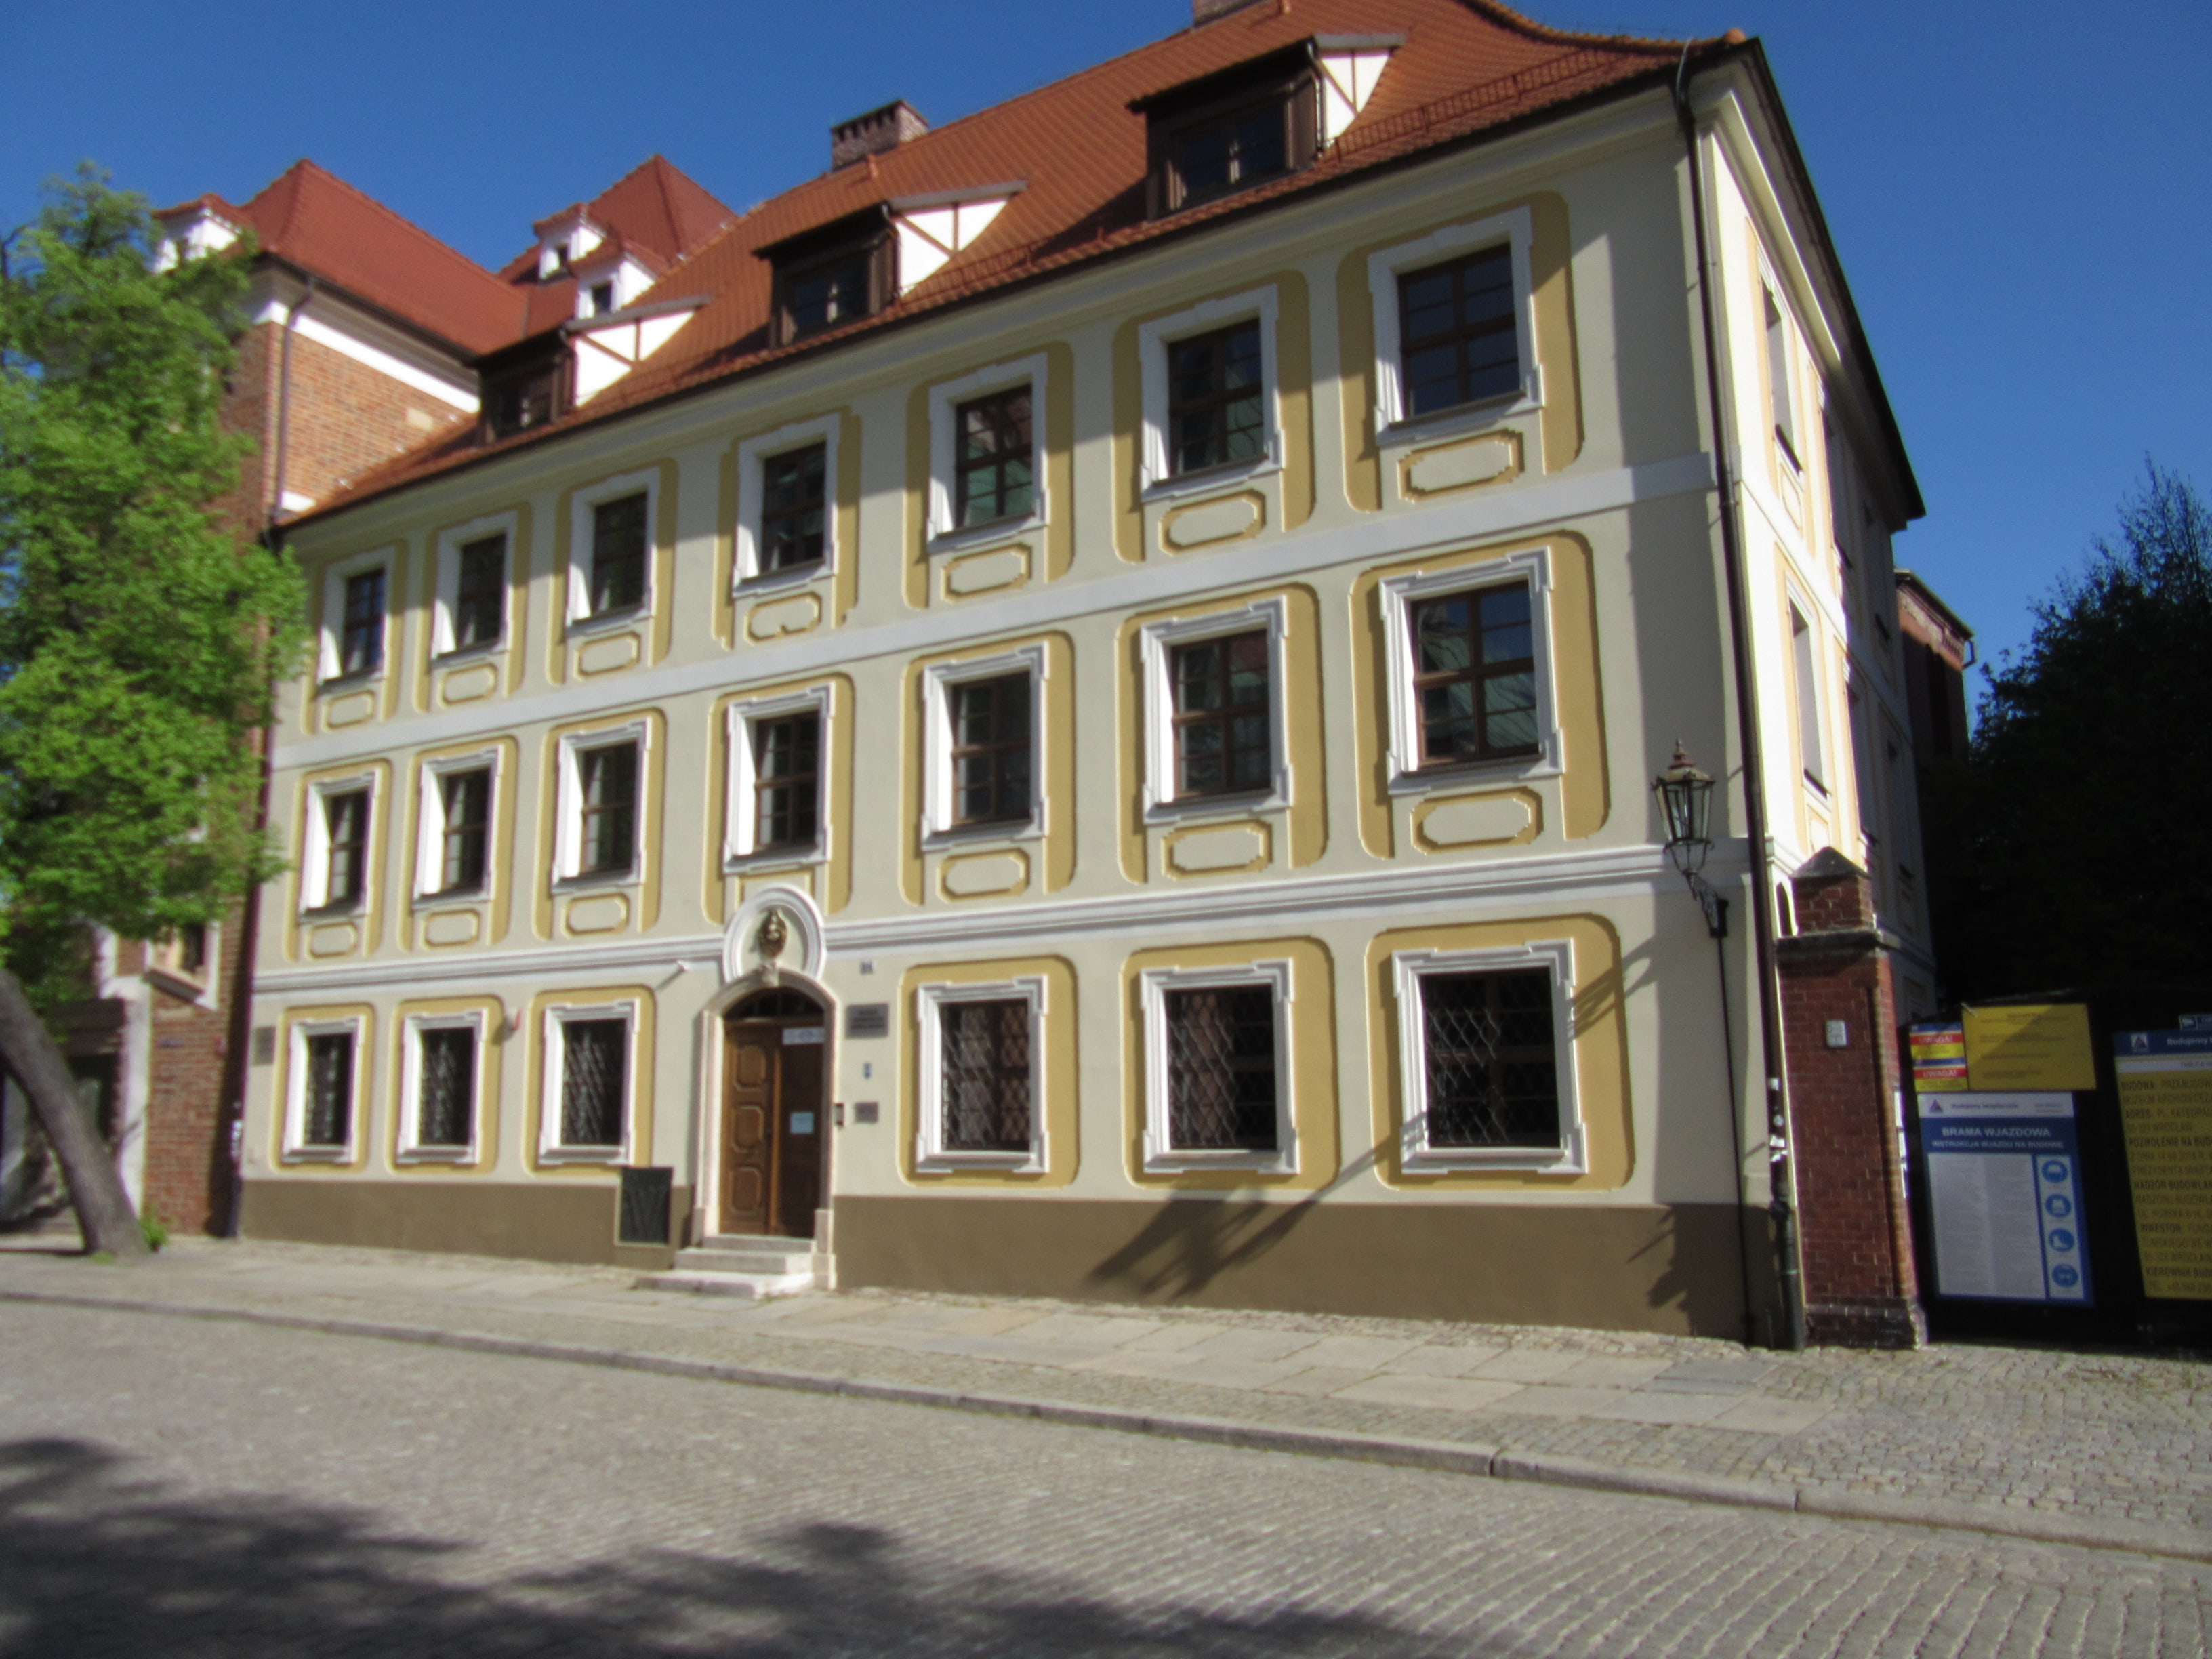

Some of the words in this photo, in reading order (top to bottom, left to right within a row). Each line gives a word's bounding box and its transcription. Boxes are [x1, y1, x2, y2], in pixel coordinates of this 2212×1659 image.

[1919, 1036, 1952, 1044] UWAGA!
[1923, 1070, 1957, 1078] UWAGA!
[1942, 1126, 1982, 1136] BRAMA
[1984, 1127, 2051, 1137] WJAZDOWA
[2181, 1136, 2192, 1147] NA
